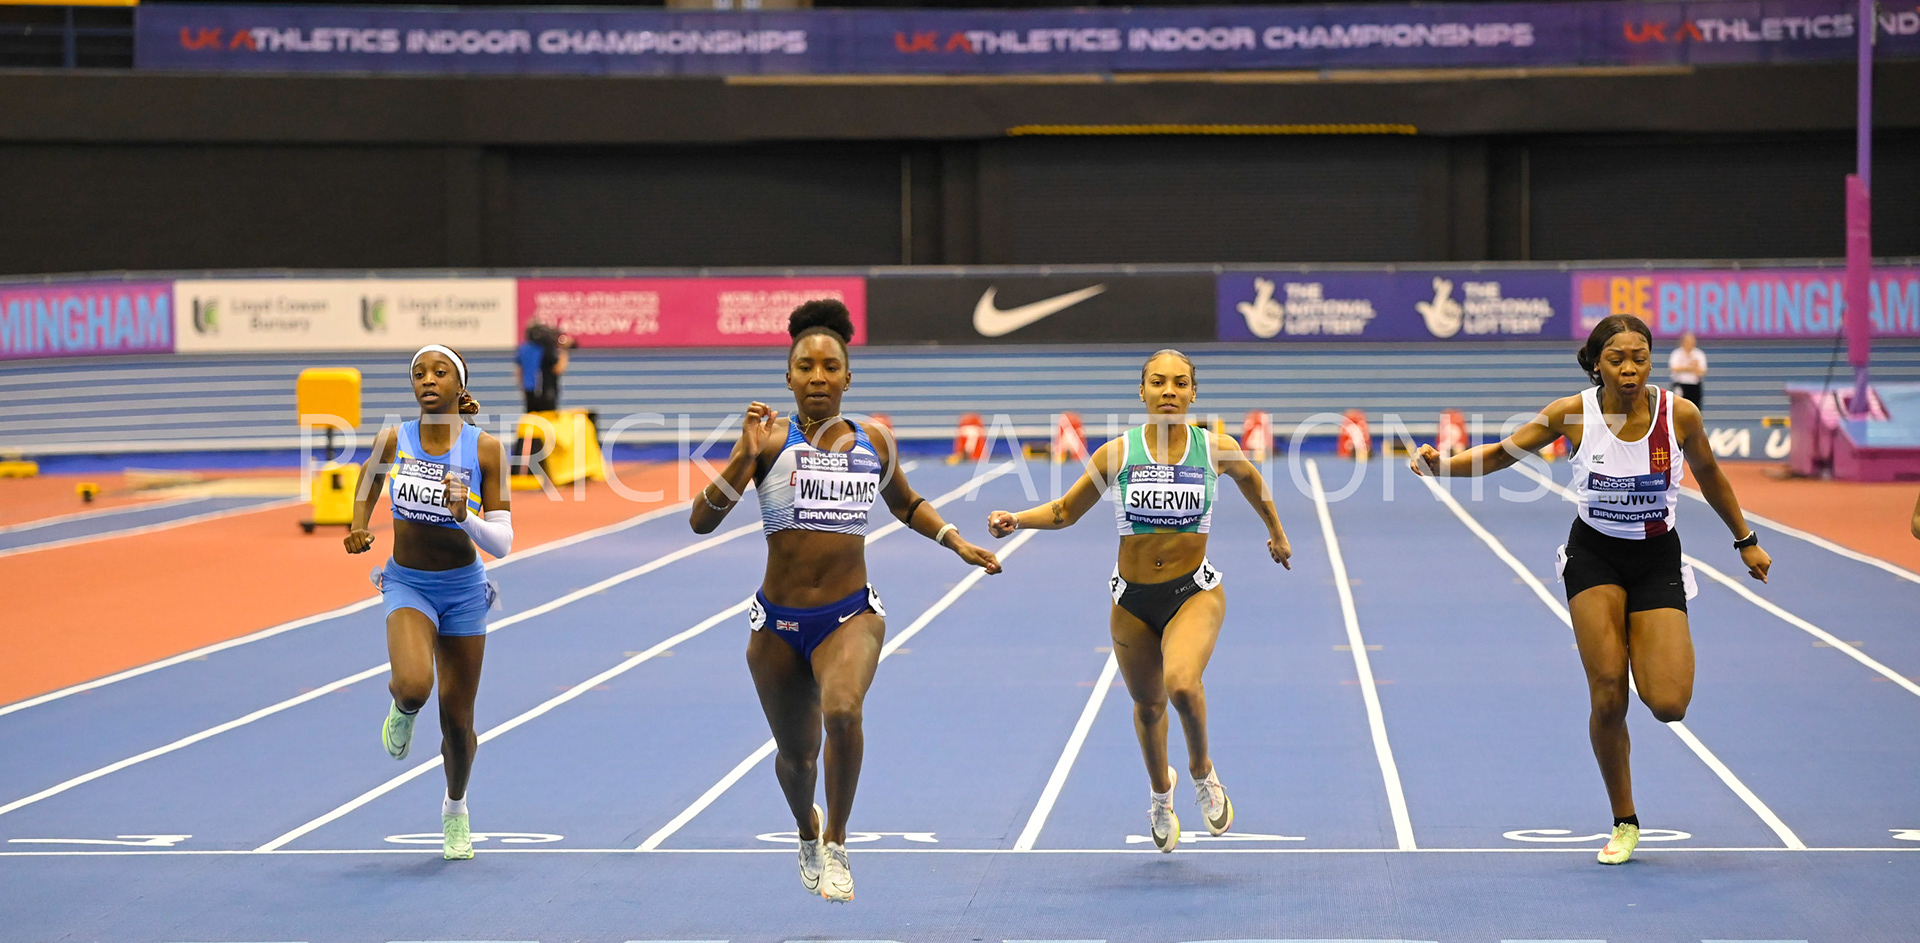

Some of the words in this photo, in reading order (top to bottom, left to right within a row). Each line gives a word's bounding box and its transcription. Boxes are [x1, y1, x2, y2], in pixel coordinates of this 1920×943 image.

[1624, 22, 1668, 43] UK
[1675, 14, 1855, 42] ATHLETICS
[180, 27, 222, 50] UK
[229, 27, 400, 52] ATHLETICS
[406, 29, 531, 53] INDOOR
[538, 29, 808, 54] CHAMPIONSHIPS
[895, 31, 938, 52] UK
[946, 27, 1122, 53] ATHLETICS
[1127, 27, 1256, 51] INDOOR
[1262, 22, 1536, 49] CHAMPIONSHIPS
[801, 457, 848, 466] INDOOR
[403, 464, 443, 477] INDOOR
[1131, 470, 1174, 478] INDOOR
[800, 478, 876, 504] WILLIAMS
[1592, 479, 1635, 488] INDOOR
[1130, 490, 1200, 510] SKERVIN
[1592, 509, 1663, 521] BIRMINGHAM
